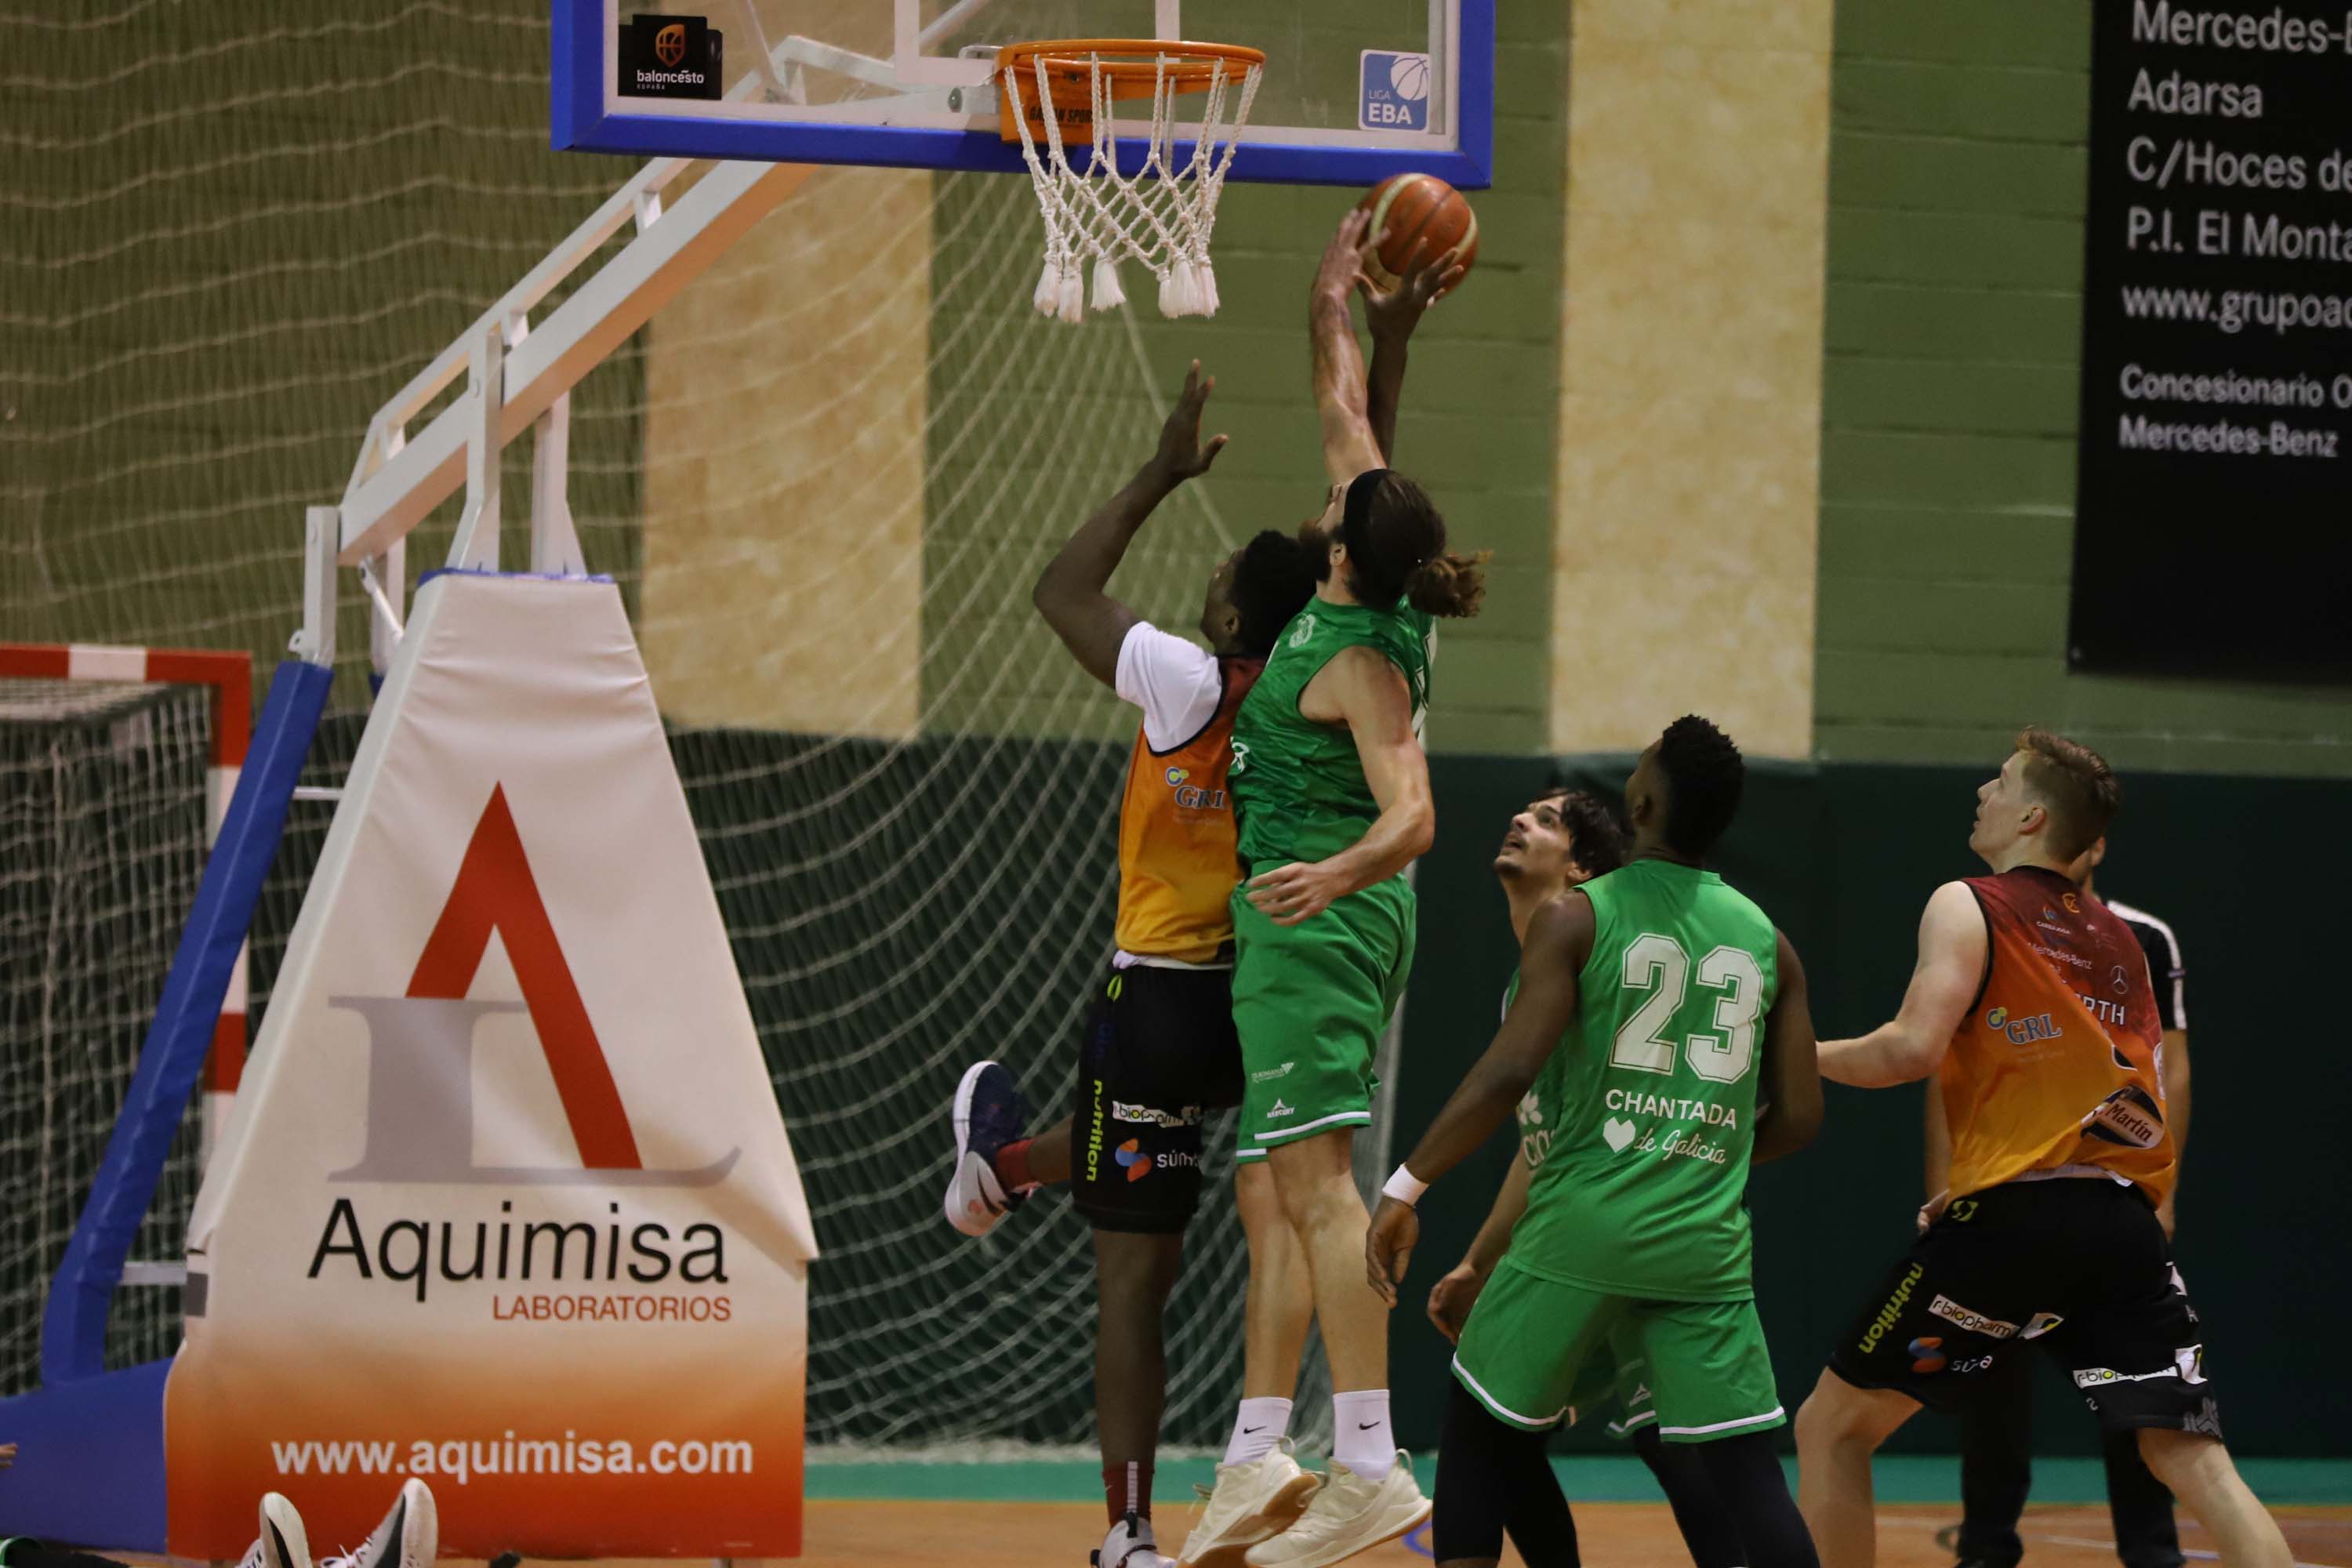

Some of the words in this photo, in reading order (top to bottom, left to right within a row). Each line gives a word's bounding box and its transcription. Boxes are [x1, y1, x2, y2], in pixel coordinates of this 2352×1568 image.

[1368, 89, 1391, 100] LIGA
[1368, 102, 1412, 125] EBA
[2127, 67, 2263, 118] Adarsa
[2127, 135, 2307, 190] C/Hoces
[2127, 205, 2183, 252] P.I.
[2198, 209, 2230, 255] El
[2120, 363, 2325, 408] Concesionario
[2119, 413, 2339, 458] Mercedes-Benz
[1608, 933, 1763, 1085] 23
[2005, 1013, 2063, 1045] GRL
[1606, 1088, 1737, 1131] CHANTADA
[1633, 1127, 1657, 1152] de
[1661, 1129, 1726, 1164] Galicia
[307, 1196, 729, 1303] Aquimisa
[493, 1294, 731, 1323] LABORATORIOS
[1858, 1261, 1924, 1355] nutrition
[1932, 1299, 2013, 1338] r-biopharm
[271, 1428, 753, 1486] www.aquimisa.com
